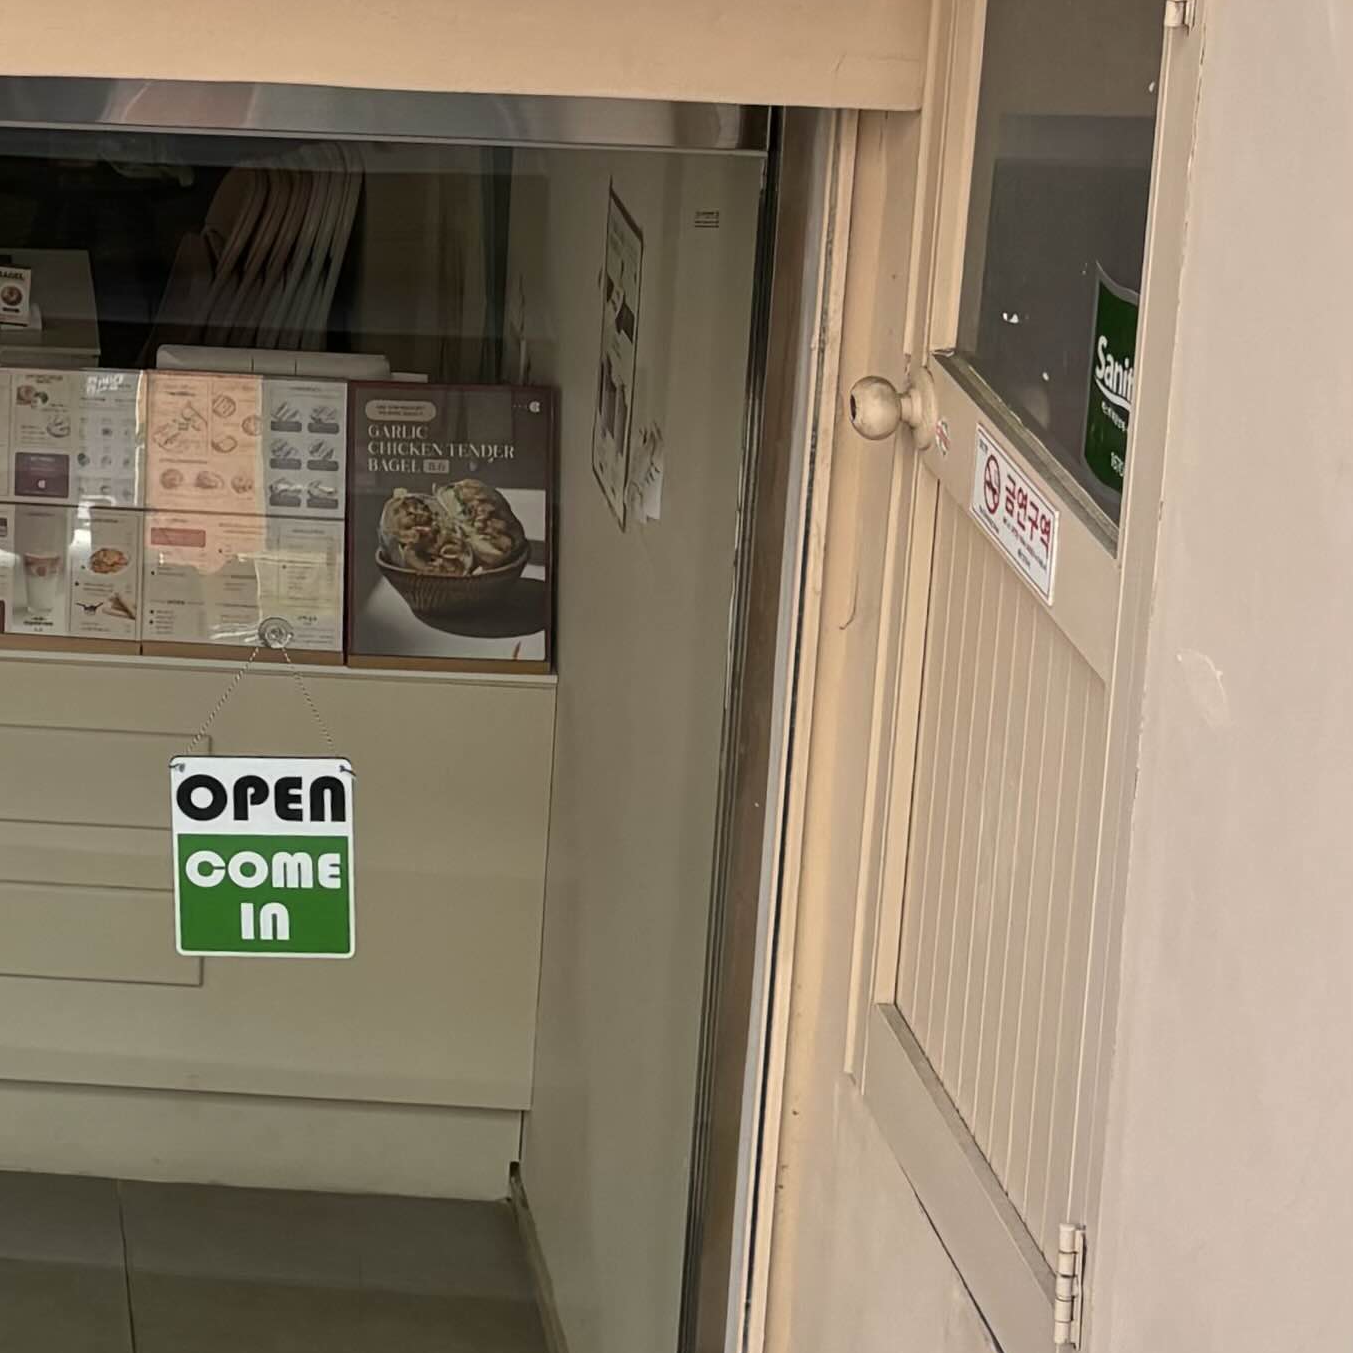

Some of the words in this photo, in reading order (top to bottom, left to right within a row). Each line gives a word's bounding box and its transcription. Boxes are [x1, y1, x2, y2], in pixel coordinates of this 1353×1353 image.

[368, 424, 427, 440] GARLIC
[368, 441, 443, 456] CHICKEN
[446, 443, 515, 459] TENDER
[368, 457, 421, 473] BAGEL
[1005, 474, 1051, 560] 금연구역
[176, 774, 346, 822] OPEN
[185, 850, 341, 889] COME
[240, 902, 290, 940] IN
